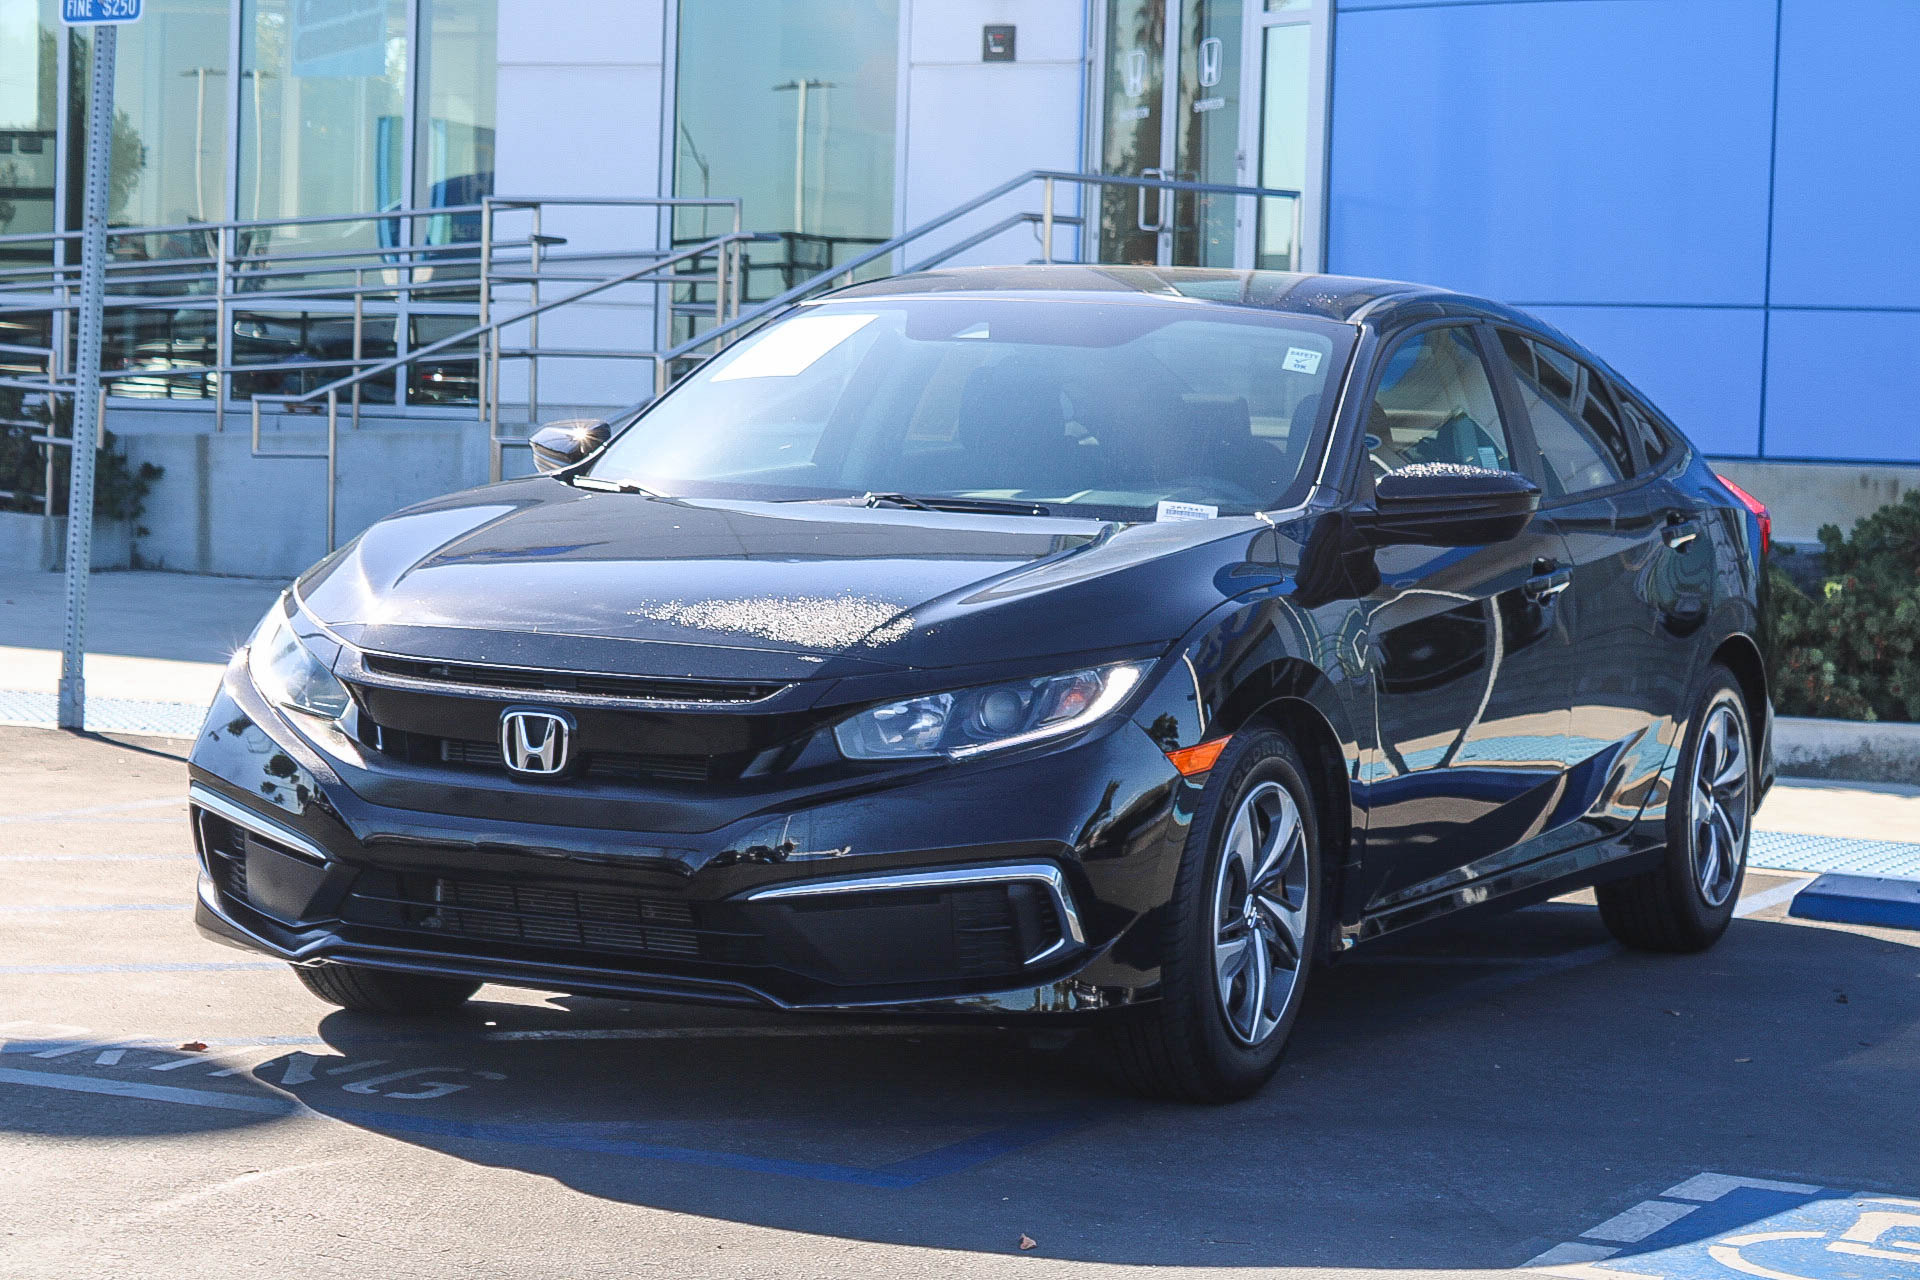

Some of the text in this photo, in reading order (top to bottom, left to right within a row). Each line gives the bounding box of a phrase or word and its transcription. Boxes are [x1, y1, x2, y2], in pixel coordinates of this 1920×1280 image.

[67, 0, 135, 17] FINE $250
[1290, 351, 1318, 359] SAFETY
